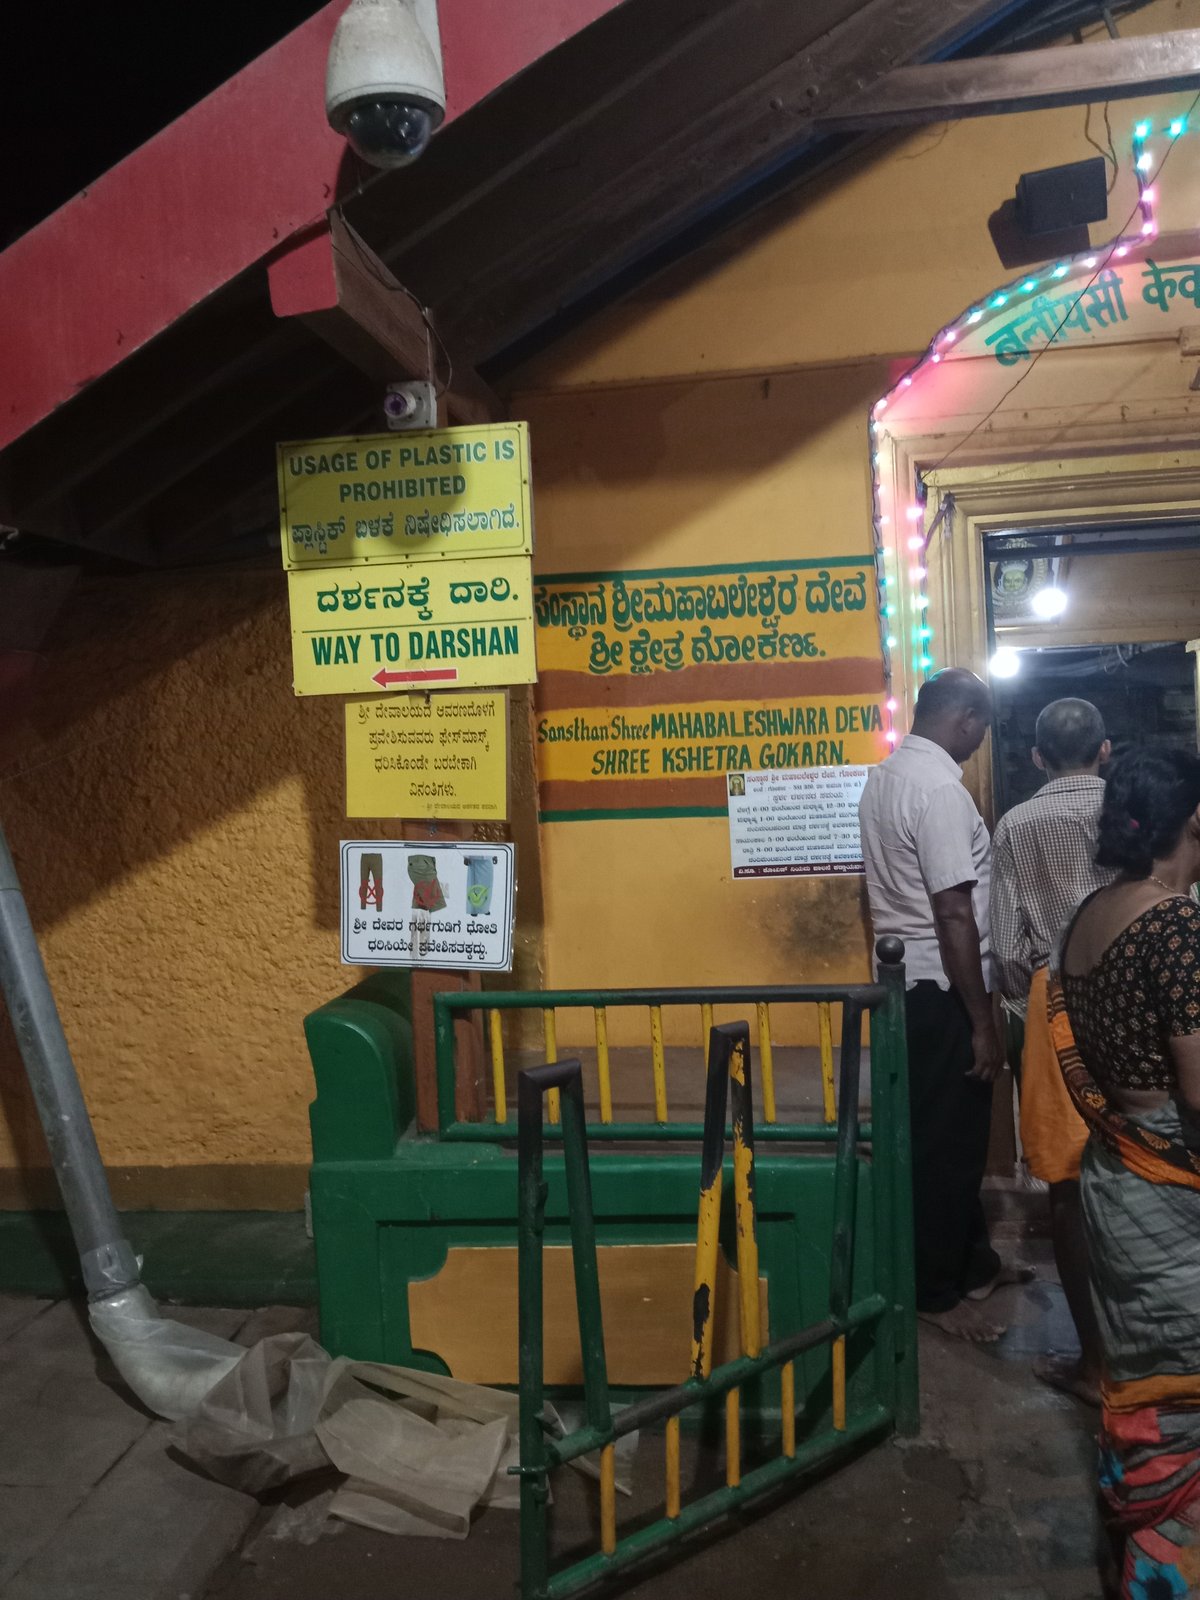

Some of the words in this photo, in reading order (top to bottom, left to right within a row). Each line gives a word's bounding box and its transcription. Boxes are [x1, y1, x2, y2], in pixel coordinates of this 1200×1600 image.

[289, 452, 358, 477] USAGE
[365, 449, 392, 471] OF
[399, 441, 487, 467] PLASTIC
[494, 439, 515, 460] IS
[339, 474, 466, 503] PROHIBITED
[291, 515, 346, 555] ಪ್ಲಾಸ್ಟಿಕ್
[354, 511, 394, 539] ಬಳಕೆ
[404, 502, 520, 538] ನಿಷೇಧಿಸಲಾಗಿದೆ.
[316, 576, 433, 621] ದರ್ಶನಕ್ಕೆ
[449, 576, 519, 605] ದಾರಿ.
[805, 570, 867, 614] ದೇವ
[311, 634, 362, 666] WAY
[370, 632, 400, 663] TO
[408, 625, 520, 661] DARSHAN
[589, 630, 623, 674] ಶ್ರೀ
[629, 628, 685, 675] ಕ್ಷೇತ್ರ
[691, 625, 827, 664] ಗೋಕರ್ಣ.
[358, 704, 371, 725] ಶ್ರೀ
[375, 702, 432, 720] ದೇವಾಲಯದ
[537, 717, 609, 744] Sansthan
[835, 703, 884, 733] DEVA
[368, 731, 435, 751] ಪ್ರವೇಶಿಸುವವರು
[591, 748, 651, 776] SHREE
[661, 742, 753, 774] KSHETRA
[758, 739, 850, 770] GOKARN.
[433, 754, 477, 771] ಬರಬೇಕಾಗಿ
[353, 918, 368, 934] ಶ್ರೀ
[372, 917, 404, 932] ದೇವರ
[408, 919, 462, 935] ಗರ್ಭಗುಡಿಗೆ
[466, 919, 498, 936] ಧೋತಿ
[367, 938, 414, 953] ಧರಿಸಿಯೇ
